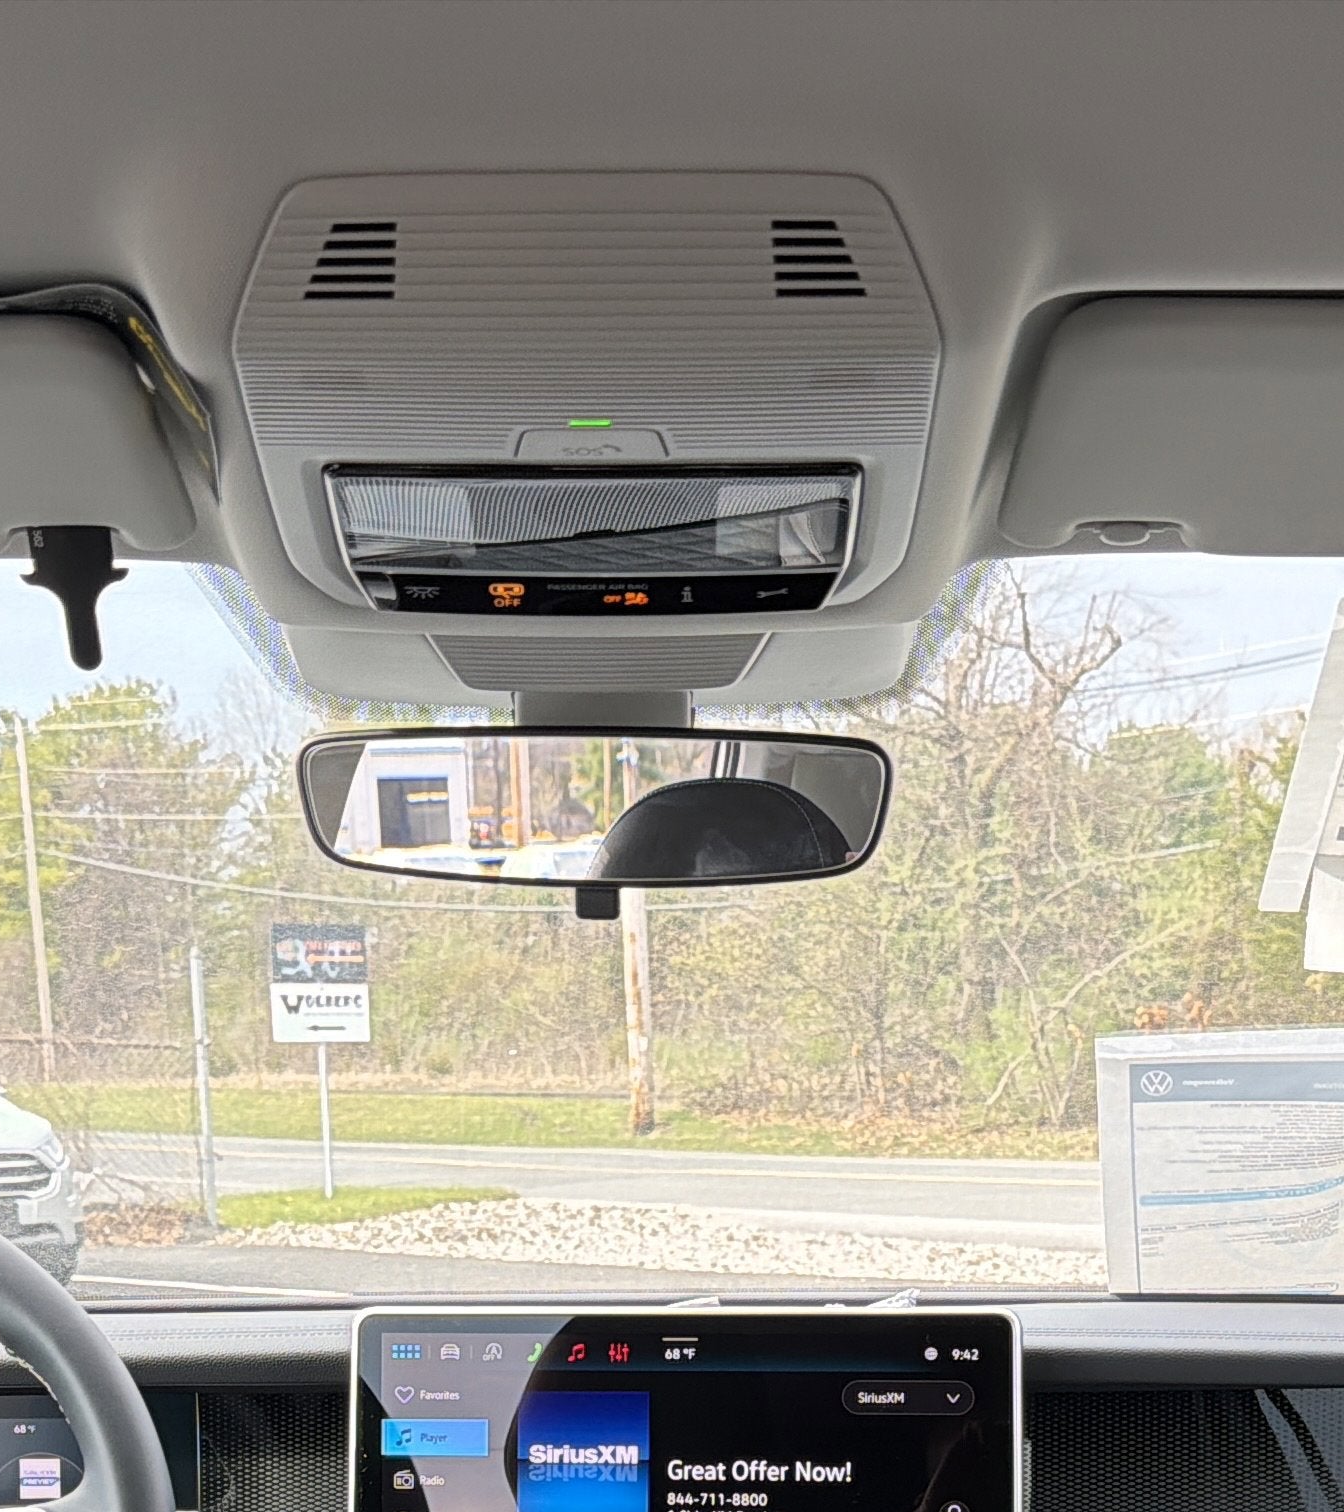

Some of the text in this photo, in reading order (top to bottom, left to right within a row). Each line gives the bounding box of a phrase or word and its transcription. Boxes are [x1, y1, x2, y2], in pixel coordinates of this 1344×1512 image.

[546, 583, 649, 592] PASSENGER AIR BAG
[494, 597, 521, 608] OFF
[604, 594, 621, 604] OFF
[664, 1348, 681, 1360] 68
[951, 1348, 980, 1361] 9:42
[419, 1389, 461, 1401] Favorites
[857, 1391, 905, 1404] SiriusXM
[13, 1424, 27, 1435] 68
[419, 1432, 448, 1446] Player
[528, 1443, 640, 1466] SiriusXM
[666, 1459, 853, 1483] Great Offer Now!
[419, 1475, 445, 1487] Radio
[666, 1492, 768, 1507] 844-711-8800
